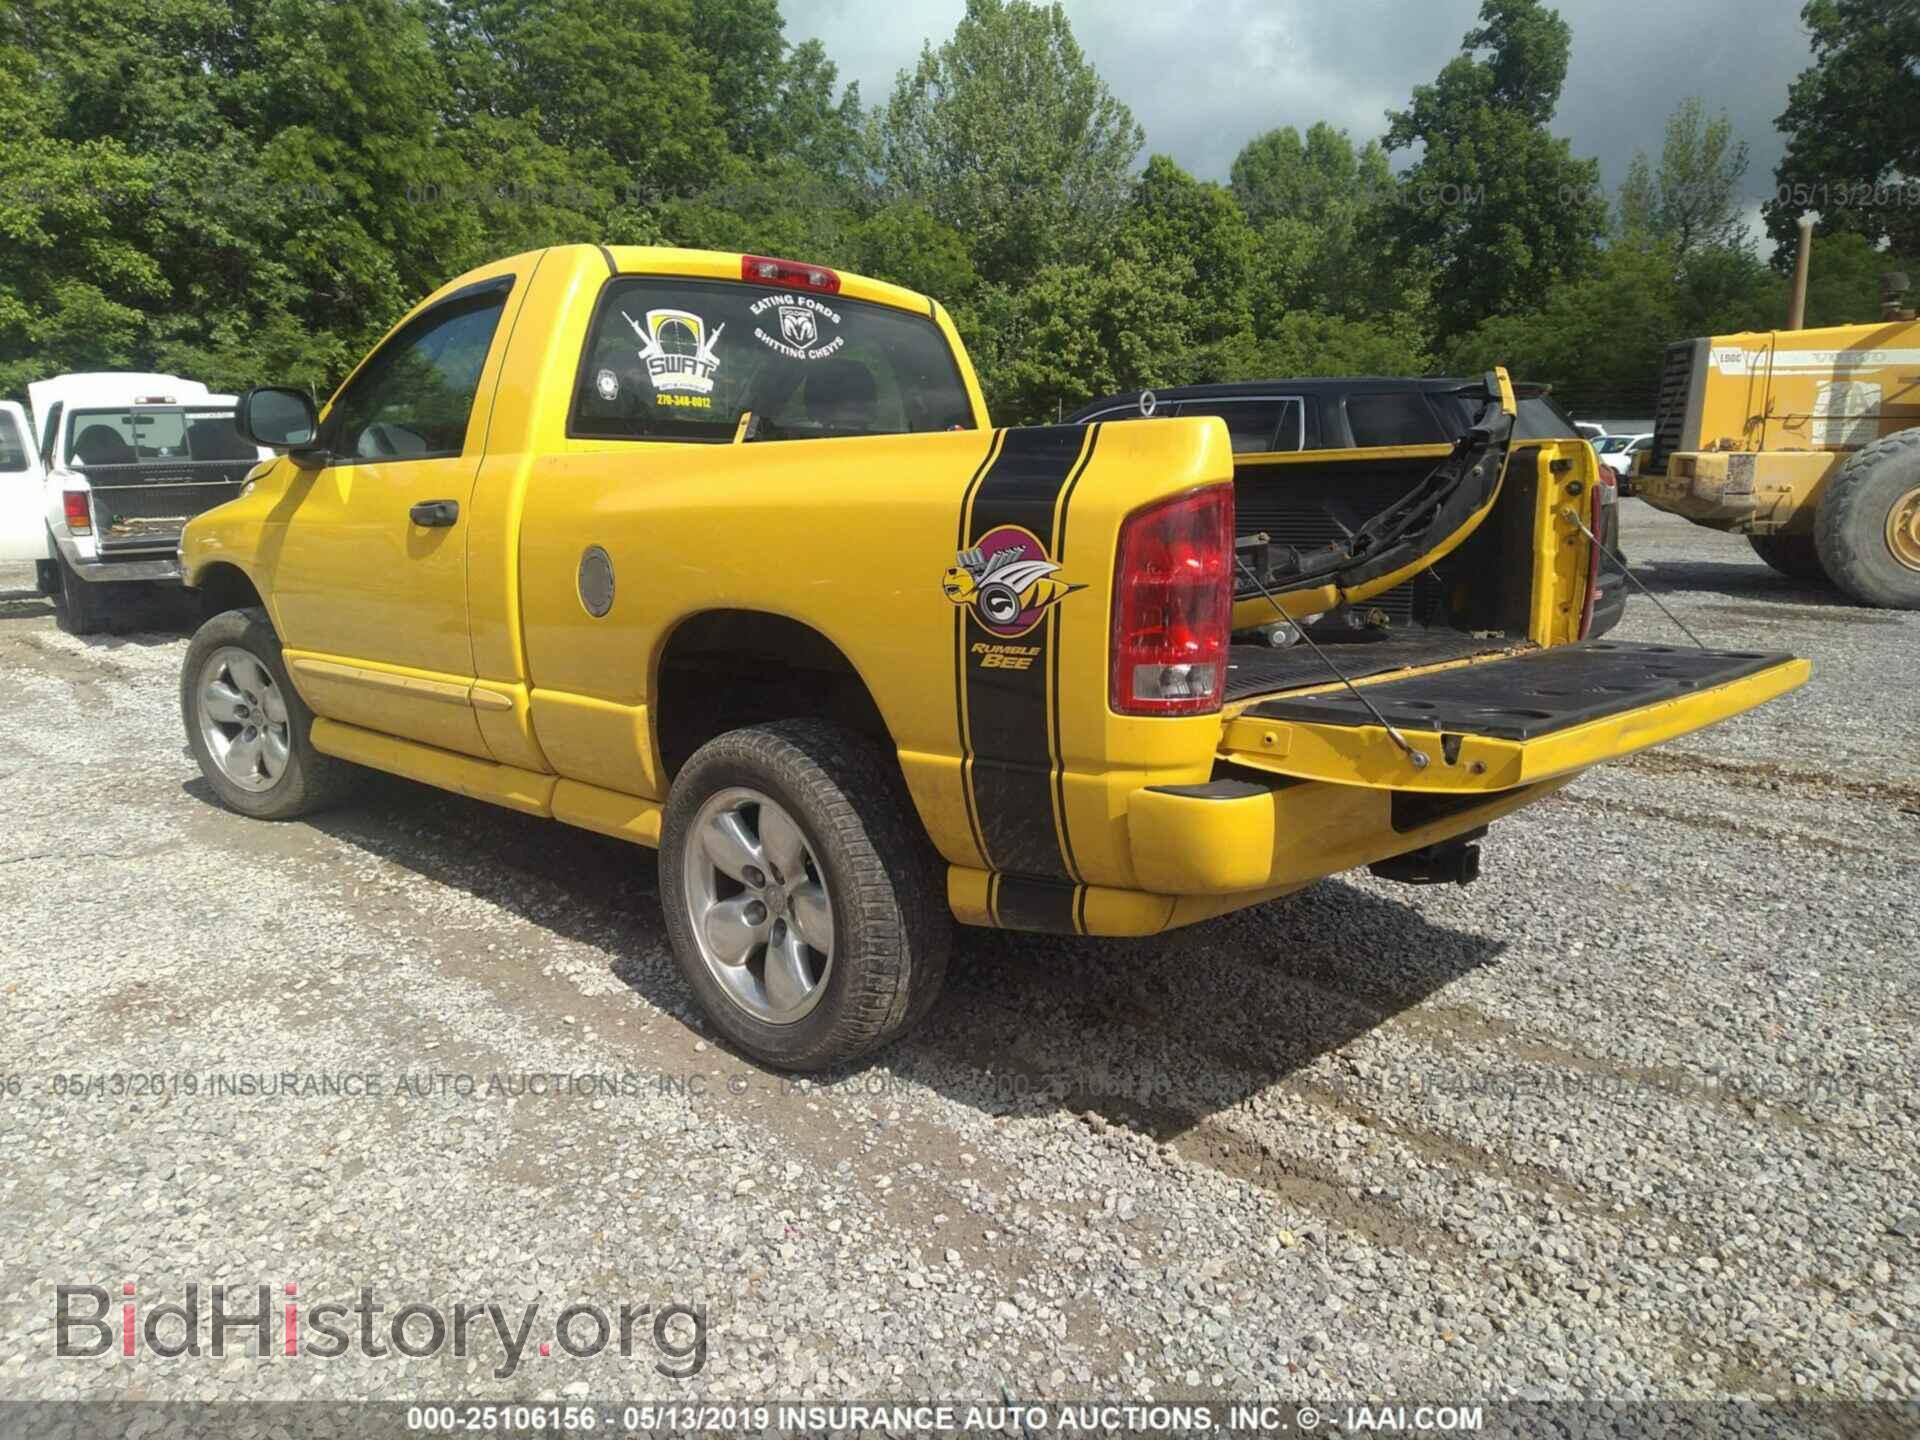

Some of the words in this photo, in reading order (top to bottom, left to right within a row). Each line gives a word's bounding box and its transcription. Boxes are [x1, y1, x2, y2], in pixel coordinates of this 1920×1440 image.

[750, 294, 794, 315] EATING
[798, 296, 841, 324] FORDS
[754, 328, 805, 359] SHITTING
[649, 356, 714, 379] SWAT
[971, 643, 1041, 655] RUMBLE
[980, 653, 1033, 669] BEE
